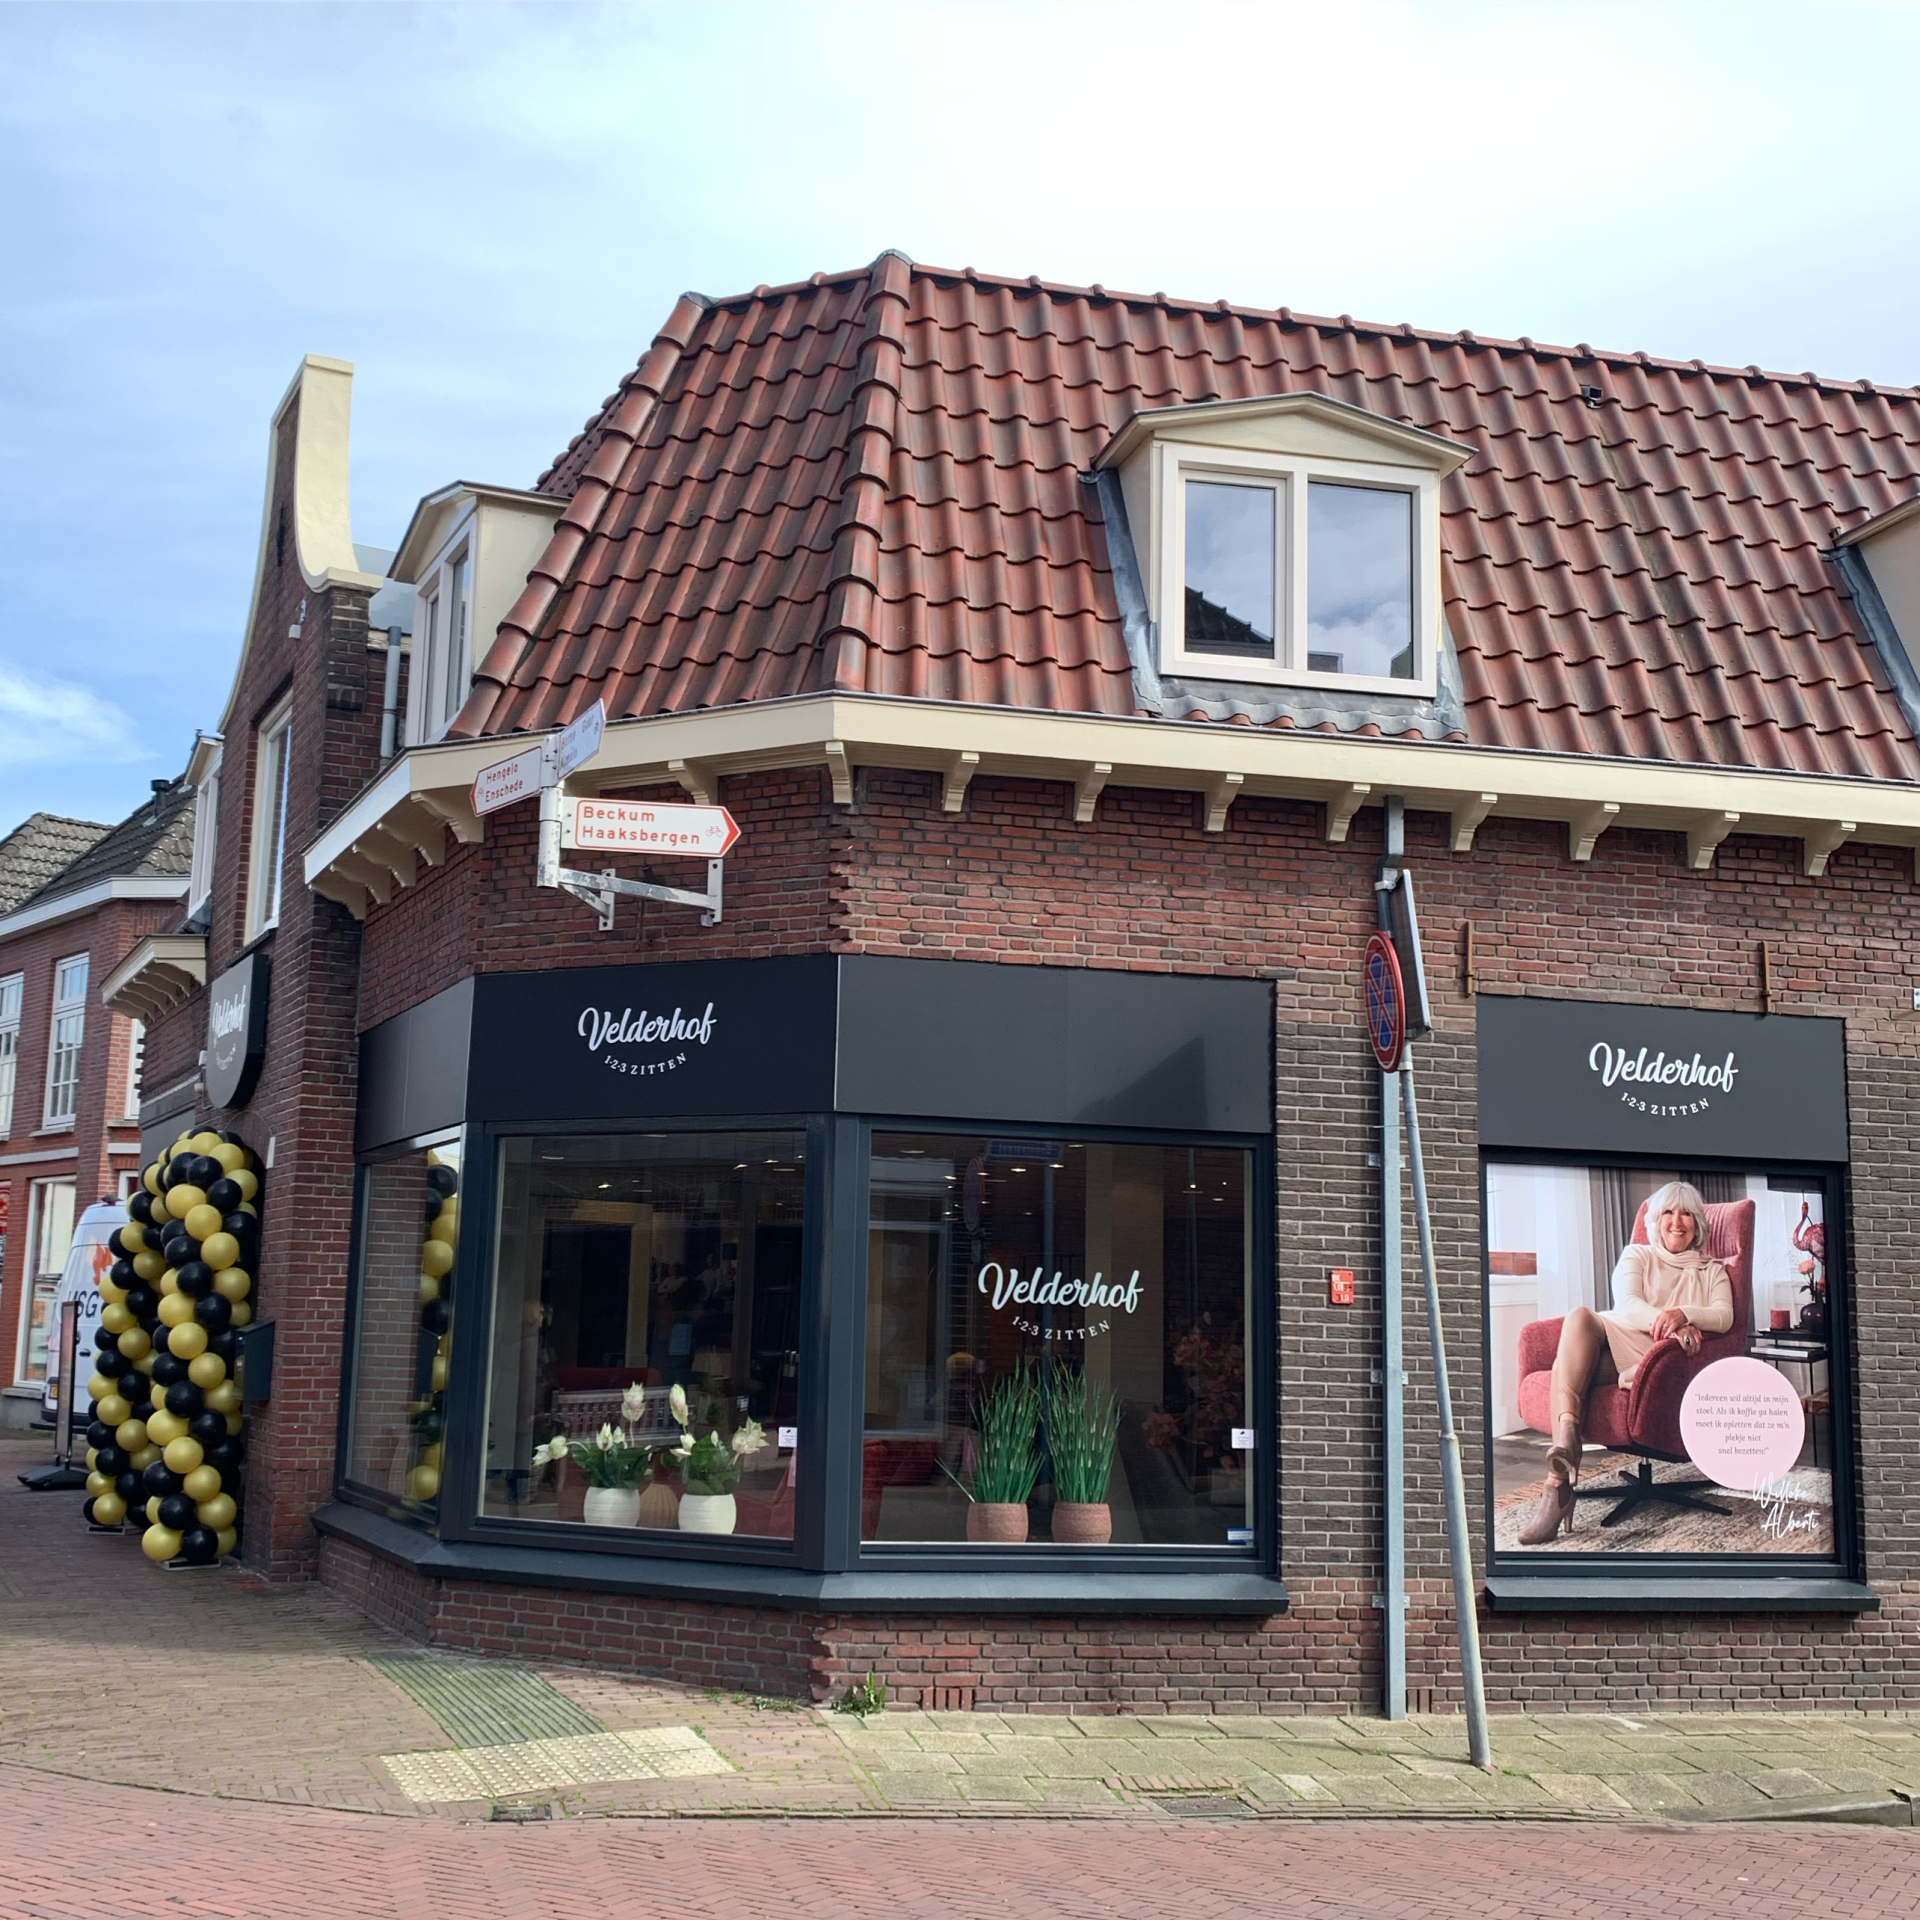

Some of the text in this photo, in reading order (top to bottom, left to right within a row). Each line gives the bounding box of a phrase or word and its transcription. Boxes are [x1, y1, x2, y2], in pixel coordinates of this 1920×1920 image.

[486, 763, 518, 785] Hengelo
[485, 779, 523, 803] Enschede
[583, 806, 655, 822] Beckum
[582, 825, 700, 846] Haaksbergen
[578, 1002, 717, 1051] Velderhof
[630, 1052, 687, 1075] ZITTEN
[1589, 1042, 1739, 1093] Velderhof
[1650, 1097, 1710, 1117] ZITTEN
[978, 1262, 1144, 1314] Velderhof
[1044, 1320, 1110, 1341] ZITTEN
[1730, 1394, 1741, 1402] wil
[1742, 1394, 1761, 1404] altijd
[1763, 1395, 1771, 1403] in
[1772, 1396, 1789, 1405] mijn
[1716, 1407, 1727, 1415] Als
[1729, 1407, 1735, 1415] ik
[1737, 1407, 1757, 1417] koffie
[1758, 1410, 1767, 1418] ga
[1768, 1408, 1788, 1416] halen
[1714, 1420, 1722, 1428] ik
[1723, 1420, 1752, 1430] opletten
[1754, 1421, 1766, 1429] dat
[1725, 1433, 1762, 1443] plekje niet
[1761, 1502, 1821, 1540] Alberti
